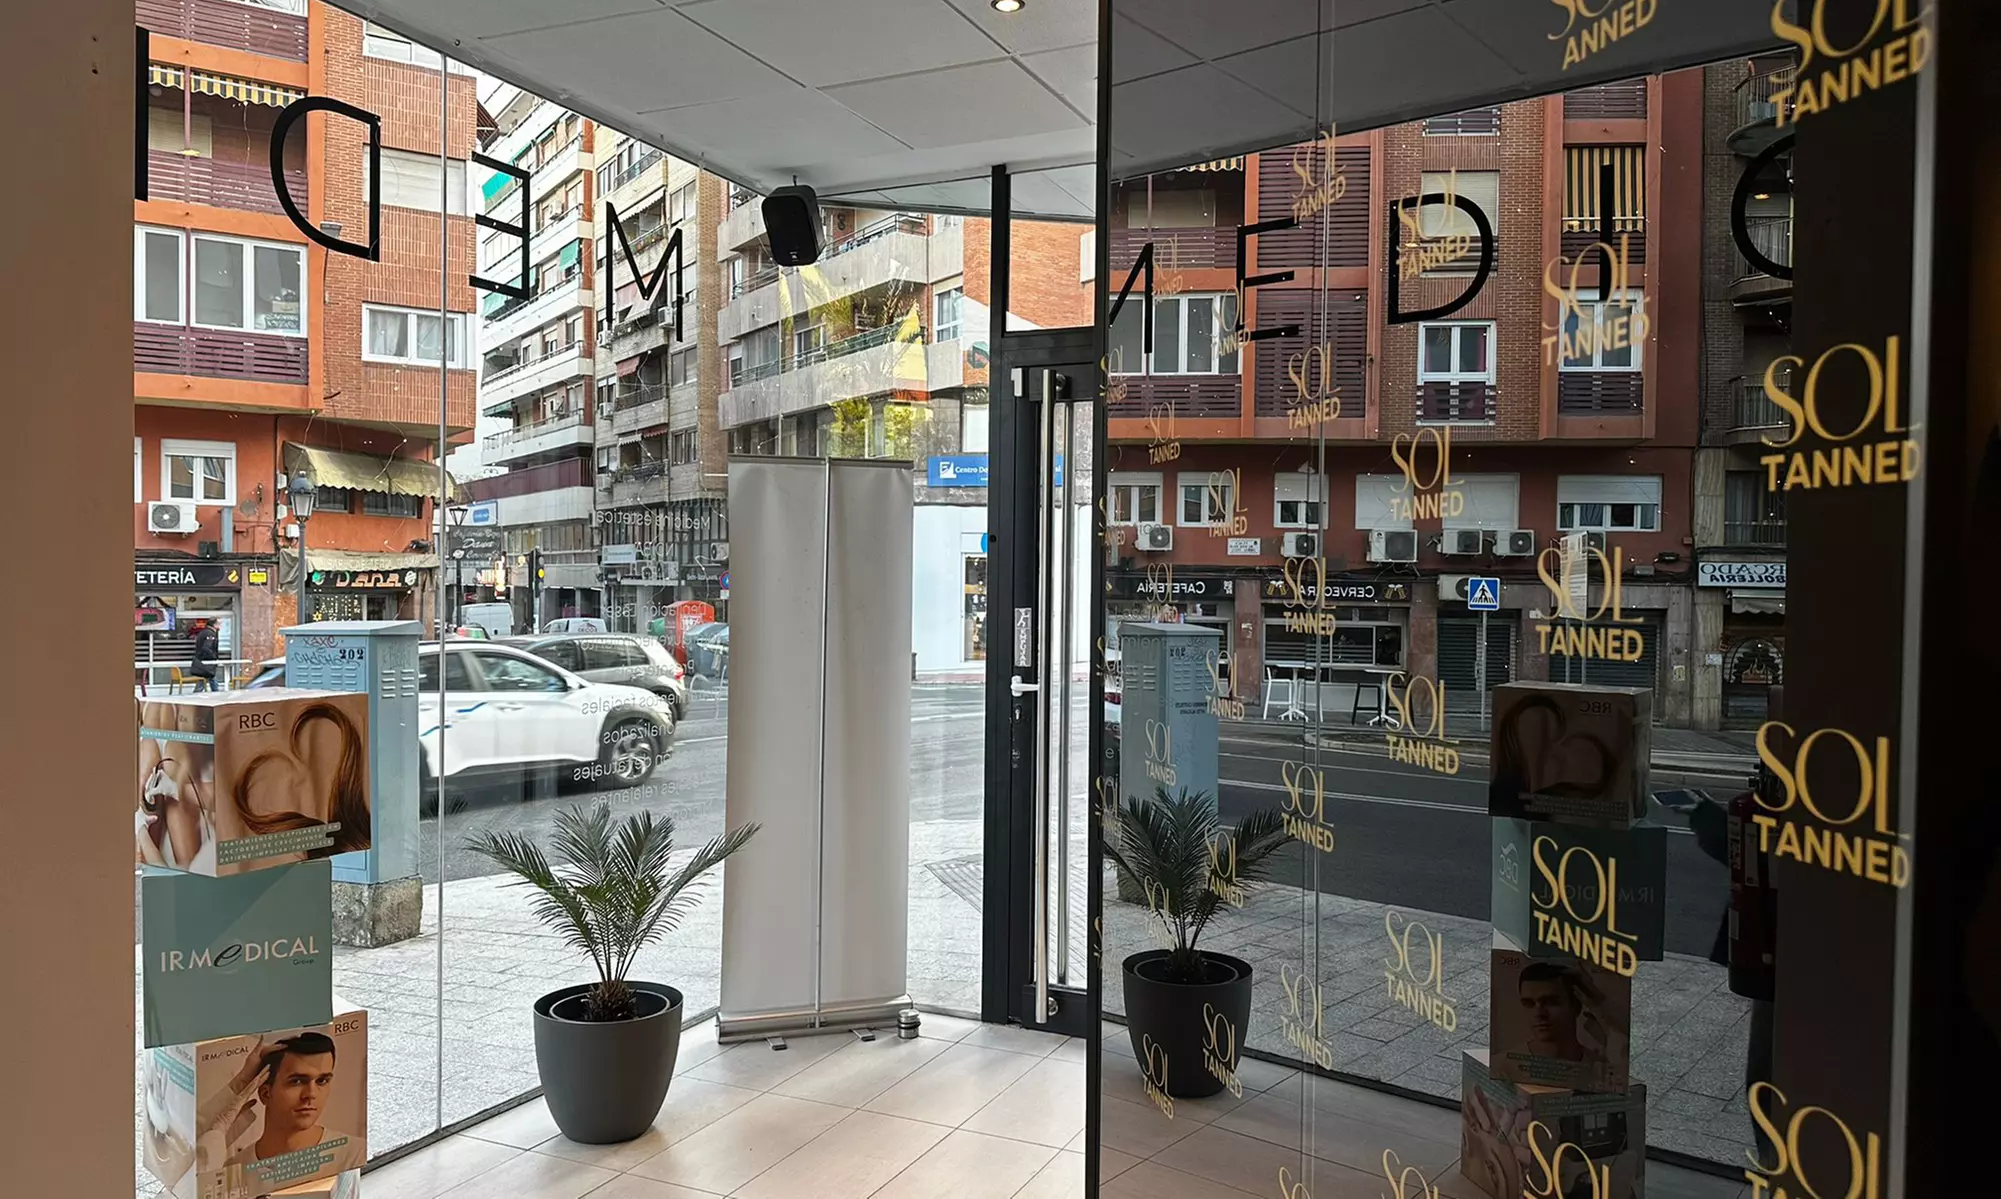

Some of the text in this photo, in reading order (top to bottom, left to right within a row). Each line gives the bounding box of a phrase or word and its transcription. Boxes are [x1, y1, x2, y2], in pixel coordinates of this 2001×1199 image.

[1770, 0, 1937, 83] SO
[1768, 27, 1932, 128] TANNED
[1293, 123, 1347, 199] SOL
[1291, 175, 1347, 223] TANNED
[1396, 230, 1471, 280] TANNED
[1542, 234, 1651, 331] SOL
[1541, 312, 1649, 366] TANNED
[1288, 342, 1342, 406] SOL
[1761, 335, 1922, 448] SOL
[1148, 400, 1181, 448] SOL
[1287, 397, 1341, 430] TANNED
[955, 465, 978, 474] Centro
[1148, 442, 1181, 464] TANNED
[1390, 426, 1465, 494] SOL
[1760, 439, 1921, 492] TANNED
[1208, 467, 1248, 518] SOL
[1390, 491, 1464, 521] TANNED
[1208, 515, 1248, 538] TANNED
[1147, 562, 1179, 603] SOL
[1284, 557, 1337, 609] SOL
[1535, 546, 1644, 623] SOL
[1284, 611, 1336, 636] TANNED
[1535, 625, 1644, 662] TANNED
[339, 649, 365, 660] 202
[1206, 649, 1245, 699] SOL
[238, 712, 277, 729] RBC
[1206, 697, 1245, 721] TANNED
[1386, 671, 1460, 744] SOL
[1145, 719, 1176, 767] SOL
[1386, 735, 1460, 775] TANNED
[1145, 760, 1176, 786] TANNED
[1281, 760, 1334, 827] SOL
[1753, 721, 1910, 839] SOL
[1204, 824, 1245, 884] SOL
[1281, 813, 1334, 852] TANNED
[1753, 813, 1910, 889] TANNED
[1204, 874, 1244, 908] TANNED
[1532, 835, 1638, 942] SOL
[1385, 911, 1457, 1002] SOL
[1533, 910, 1638, 977] TANNED
[334, 1020, 360, 1034] RBC
[1281, 963, 1333, 1045] SOL
[1385, 972, 1457, 1032] TANNED
[1202, 1003, 1243, 1075] SOL
[1281, 1016, 1333, 1071] TANNED
[1142, 1033, 1174, 1102] SOL
[1202, 1049, 1243, 1100] TANNED
[1142, 1076, 1175, 1120] TANNED
[1381, 1149, 1438, 1199] SO
